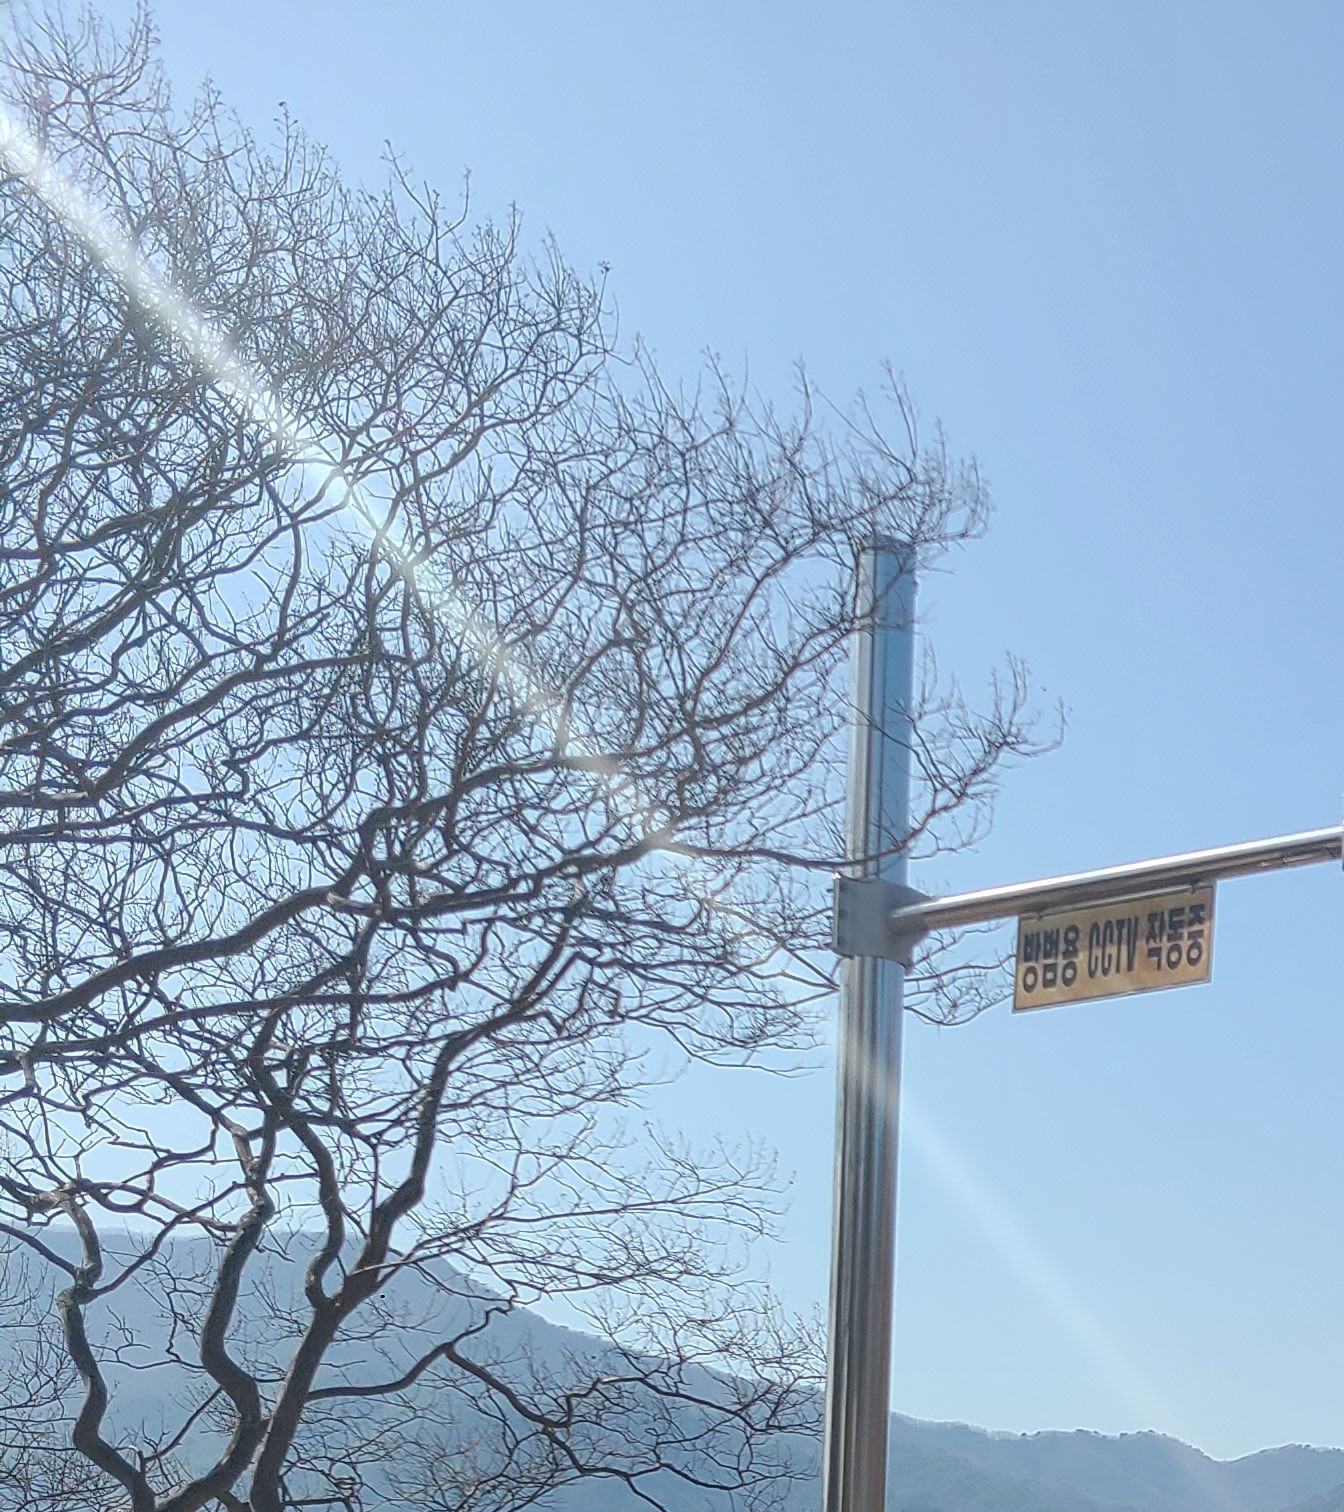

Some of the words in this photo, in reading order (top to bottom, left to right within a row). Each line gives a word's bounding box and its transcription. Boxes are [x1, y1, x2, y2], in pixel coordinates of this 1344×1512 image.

[1023, 924, 1080, 994] 방범용
[1088, 915, 1139, 980] CCTV
[1145, 903, 1206, 971] 작동중
